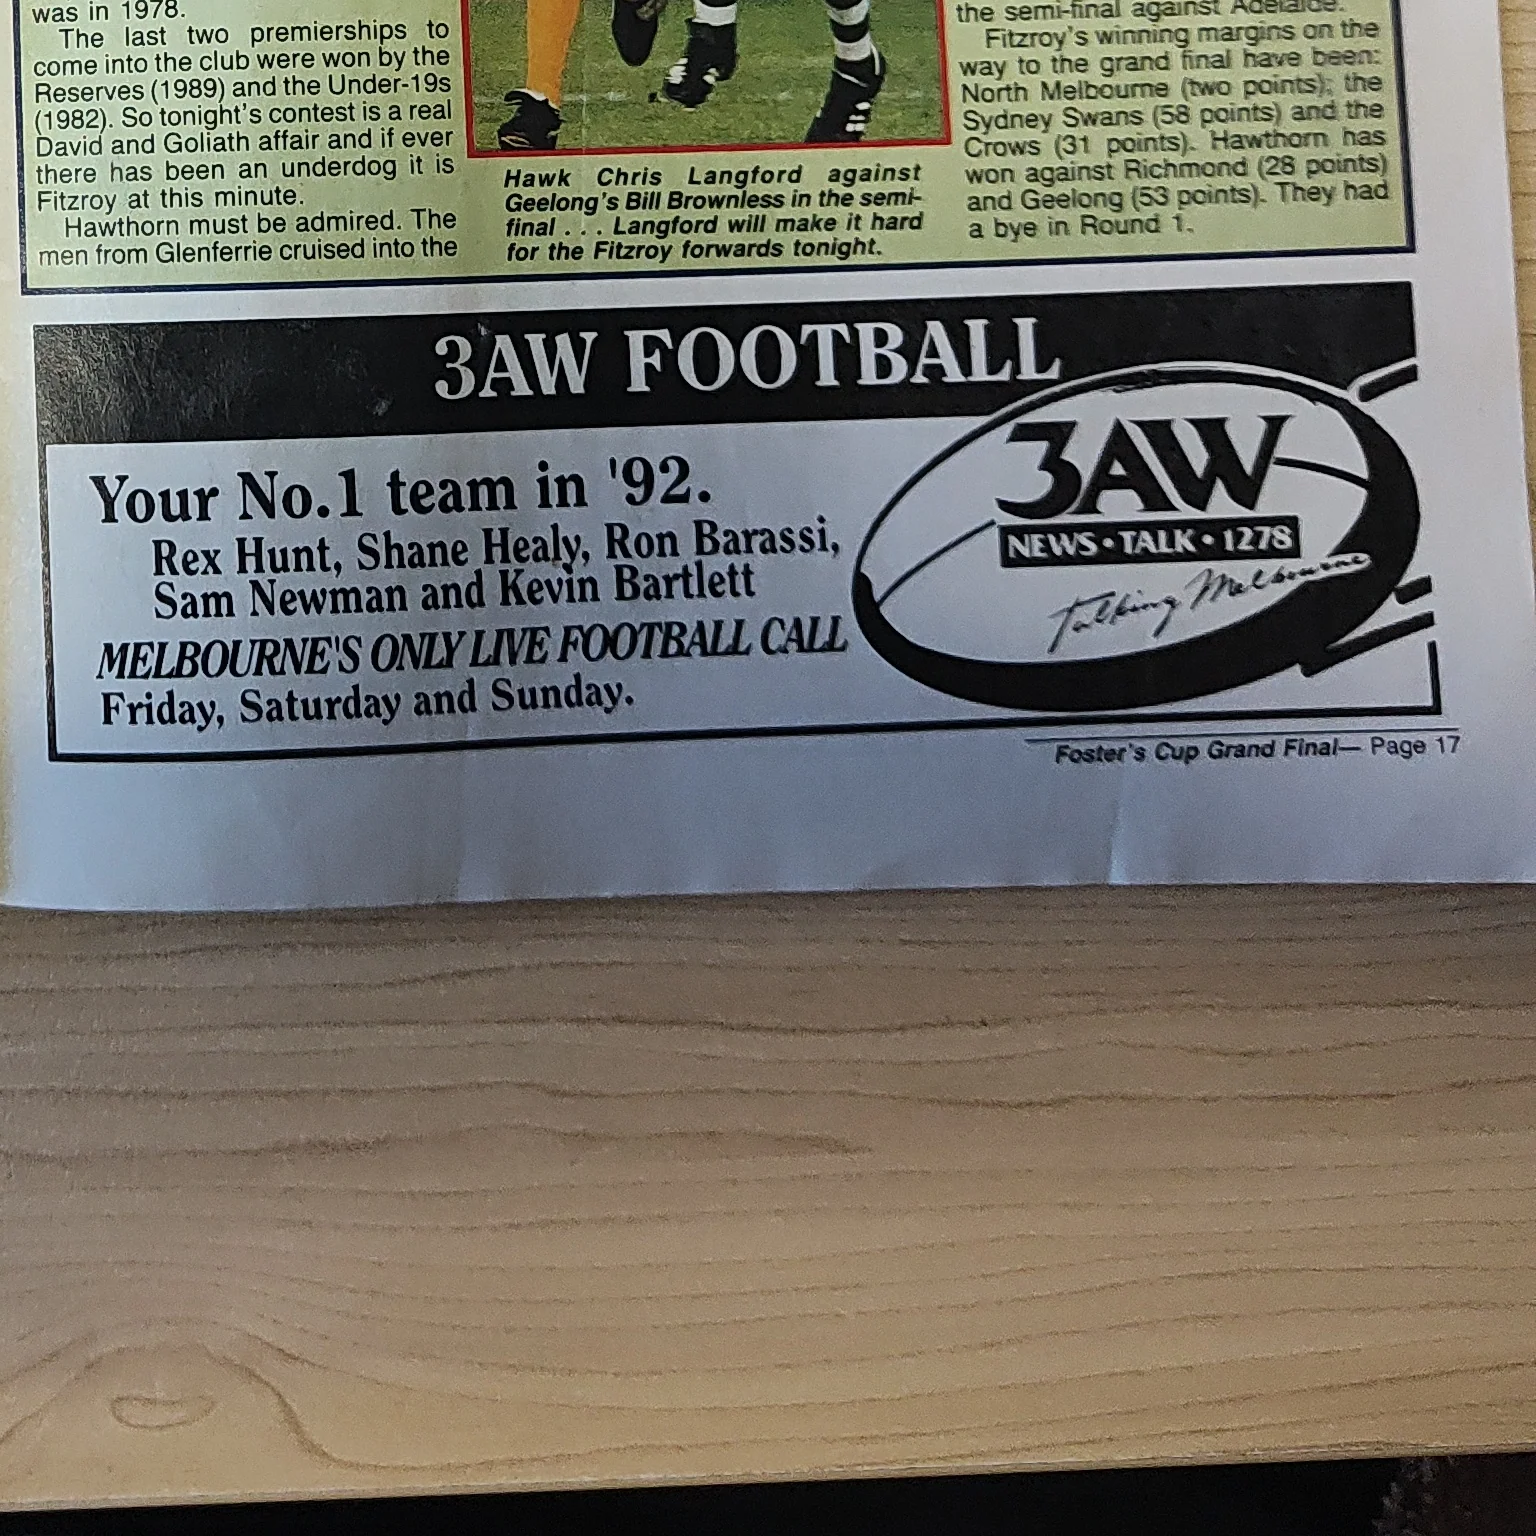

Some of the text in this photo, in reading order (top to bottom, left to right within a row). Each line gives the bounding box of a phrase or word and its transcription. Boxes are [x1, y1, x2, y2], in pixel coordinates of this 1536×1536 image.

[40, 236, 458, 266] men from Glenferrie cruised into the
[507, 237, 883, 265] for the Fitzroy forwards tonight.
[969, 213, 1195, 244] a bye in Round 1.
[434, 317, 1062, 400] 3AW FOOTBALL
[89, 475, 220, 525] Your
[237, 468, 364, 521] No.1
[386, 468, 518, 517] team
[536, 460, 589, 509] in
[995, 414, 1292, 519] 3AW
[152, 515, 841, 579] Rex Hunt, Shane Healy, Ron Barassi,
[154, 559, 756, 620] Sam Newman and Kevin Bartlett
[96, 614, 850, 681] MELBOURNE'S ONLY LIVE FOOTBALL CALL
[102, 670, 635, 733] Friday, Saturday and Sunday.
[1155, 742, 1200, 765] Cup
[1207, 739, 1277, 761] Grand
[1370, 735, 1427, 760] Page
[1436, 736, 1461, 754] 17
